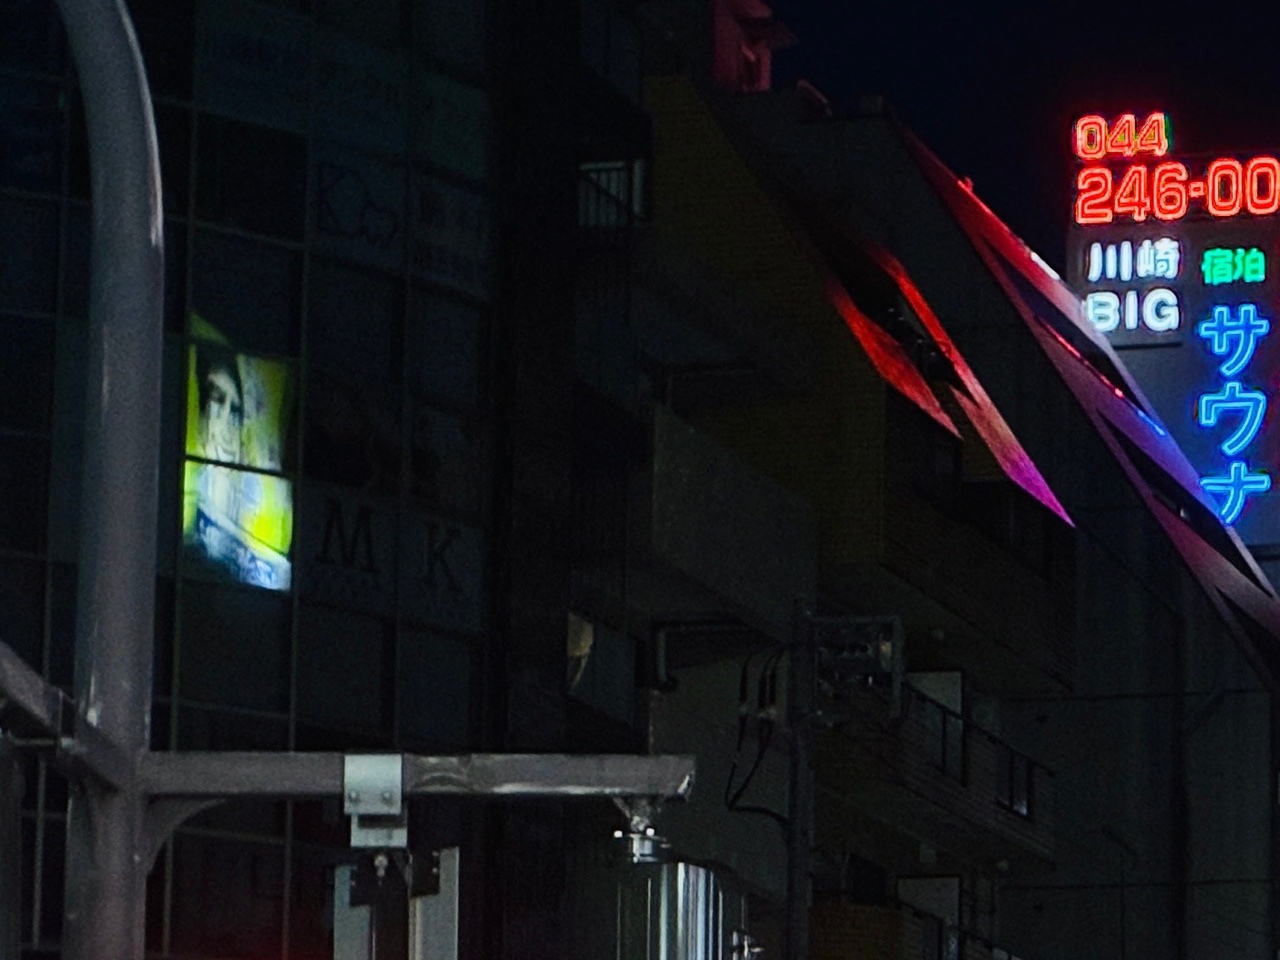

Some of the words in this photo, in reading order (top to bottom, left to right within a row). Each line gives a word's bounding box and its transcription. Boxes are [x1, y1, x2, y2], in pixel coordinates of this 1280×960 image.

[1074, 112, 1168, 159] 044
[1087, 237, 1180, 282] 川崎
[1200, 247, 1267, 285] 宿泊
[1085, 288, 1180, 331] BIG
[1198, 303, 1271, 526] サウナ
